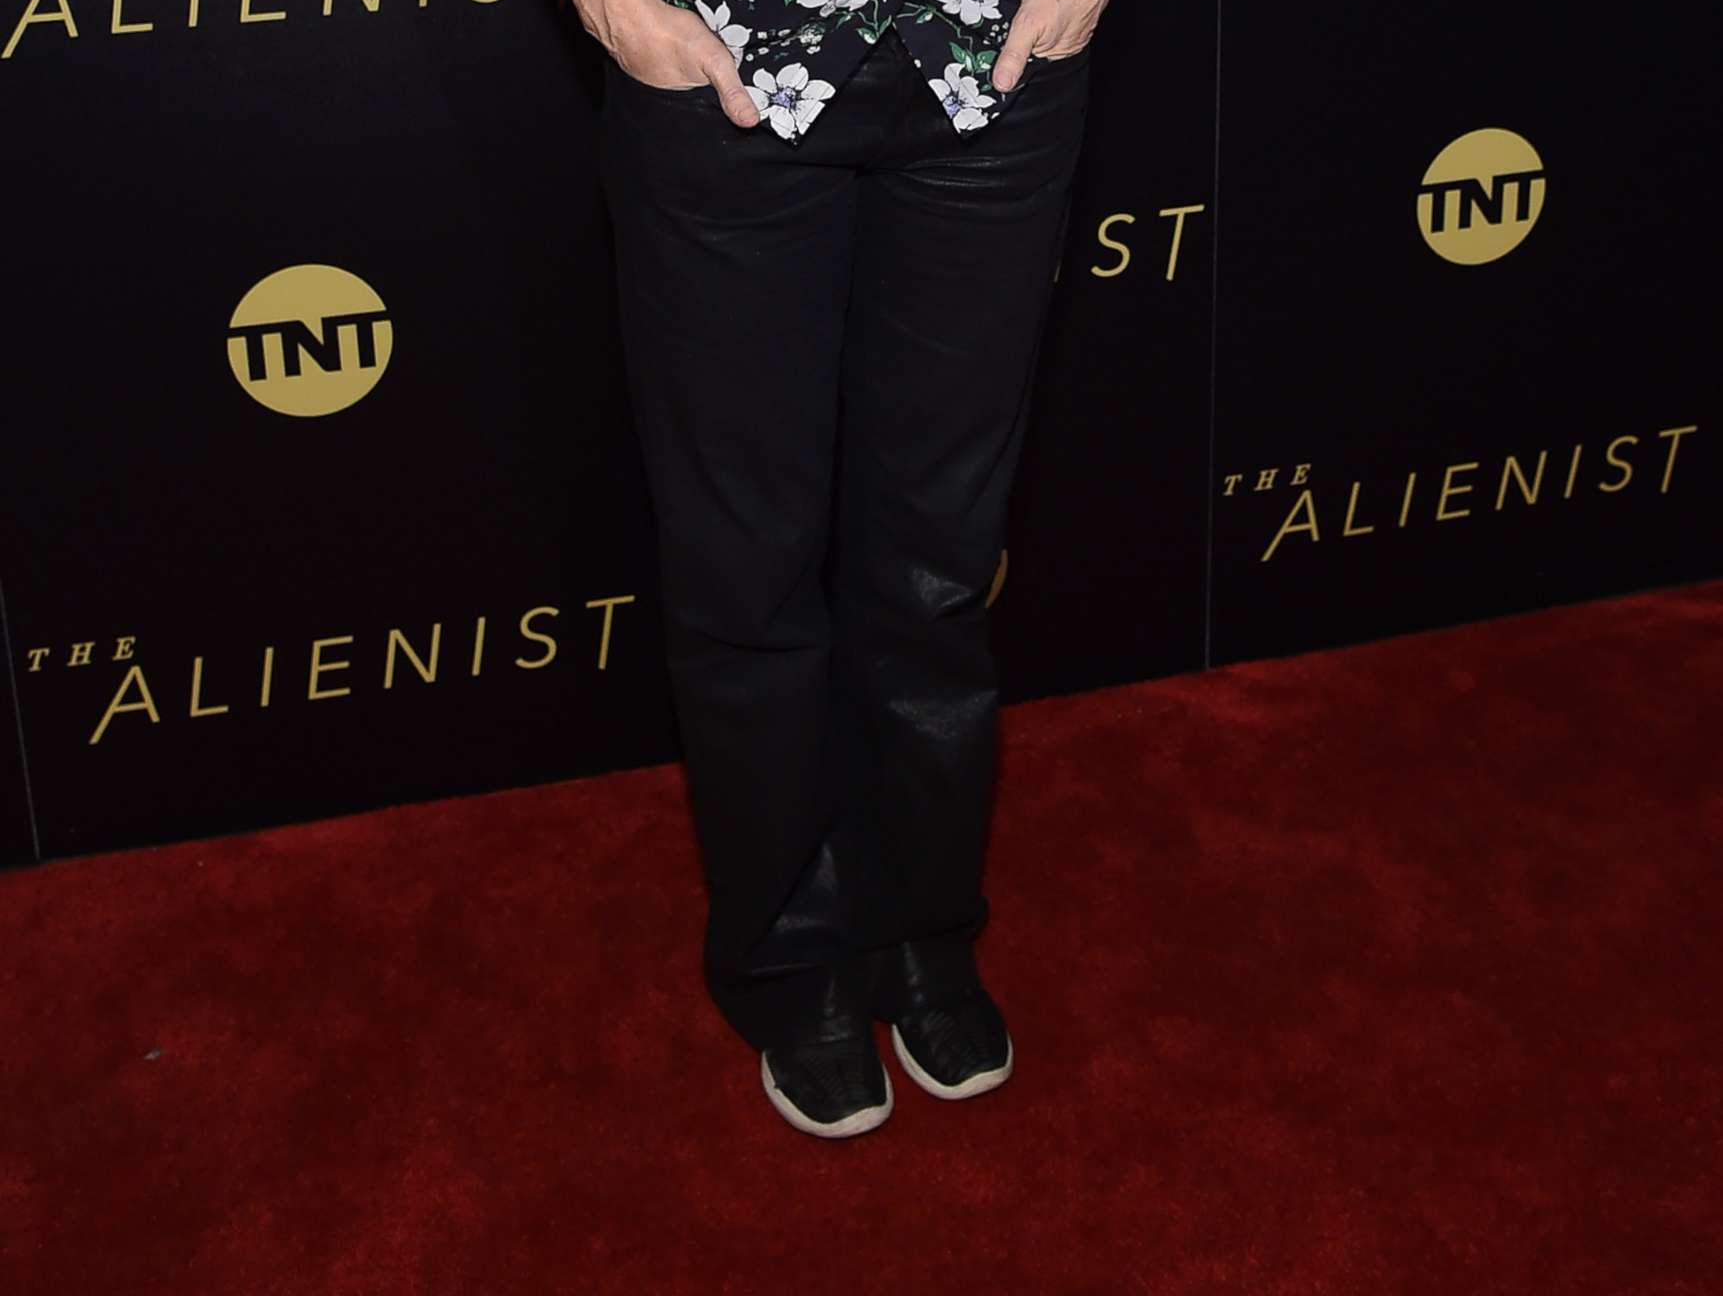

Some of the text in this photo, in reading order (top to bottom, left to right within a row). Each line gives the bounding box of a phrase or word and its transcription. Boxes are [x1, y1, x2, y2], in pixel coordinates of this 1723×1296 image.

[1417, 169, 1546, 234] TNT
[226, 310, 393, 382] TNT
[1224, 463, 1312, 497] THE
[1262, 425, 1698, 562] ALIENIST
[27, 636, 137, 673] THE
[89, 595, 636, 745] ALIENIST
